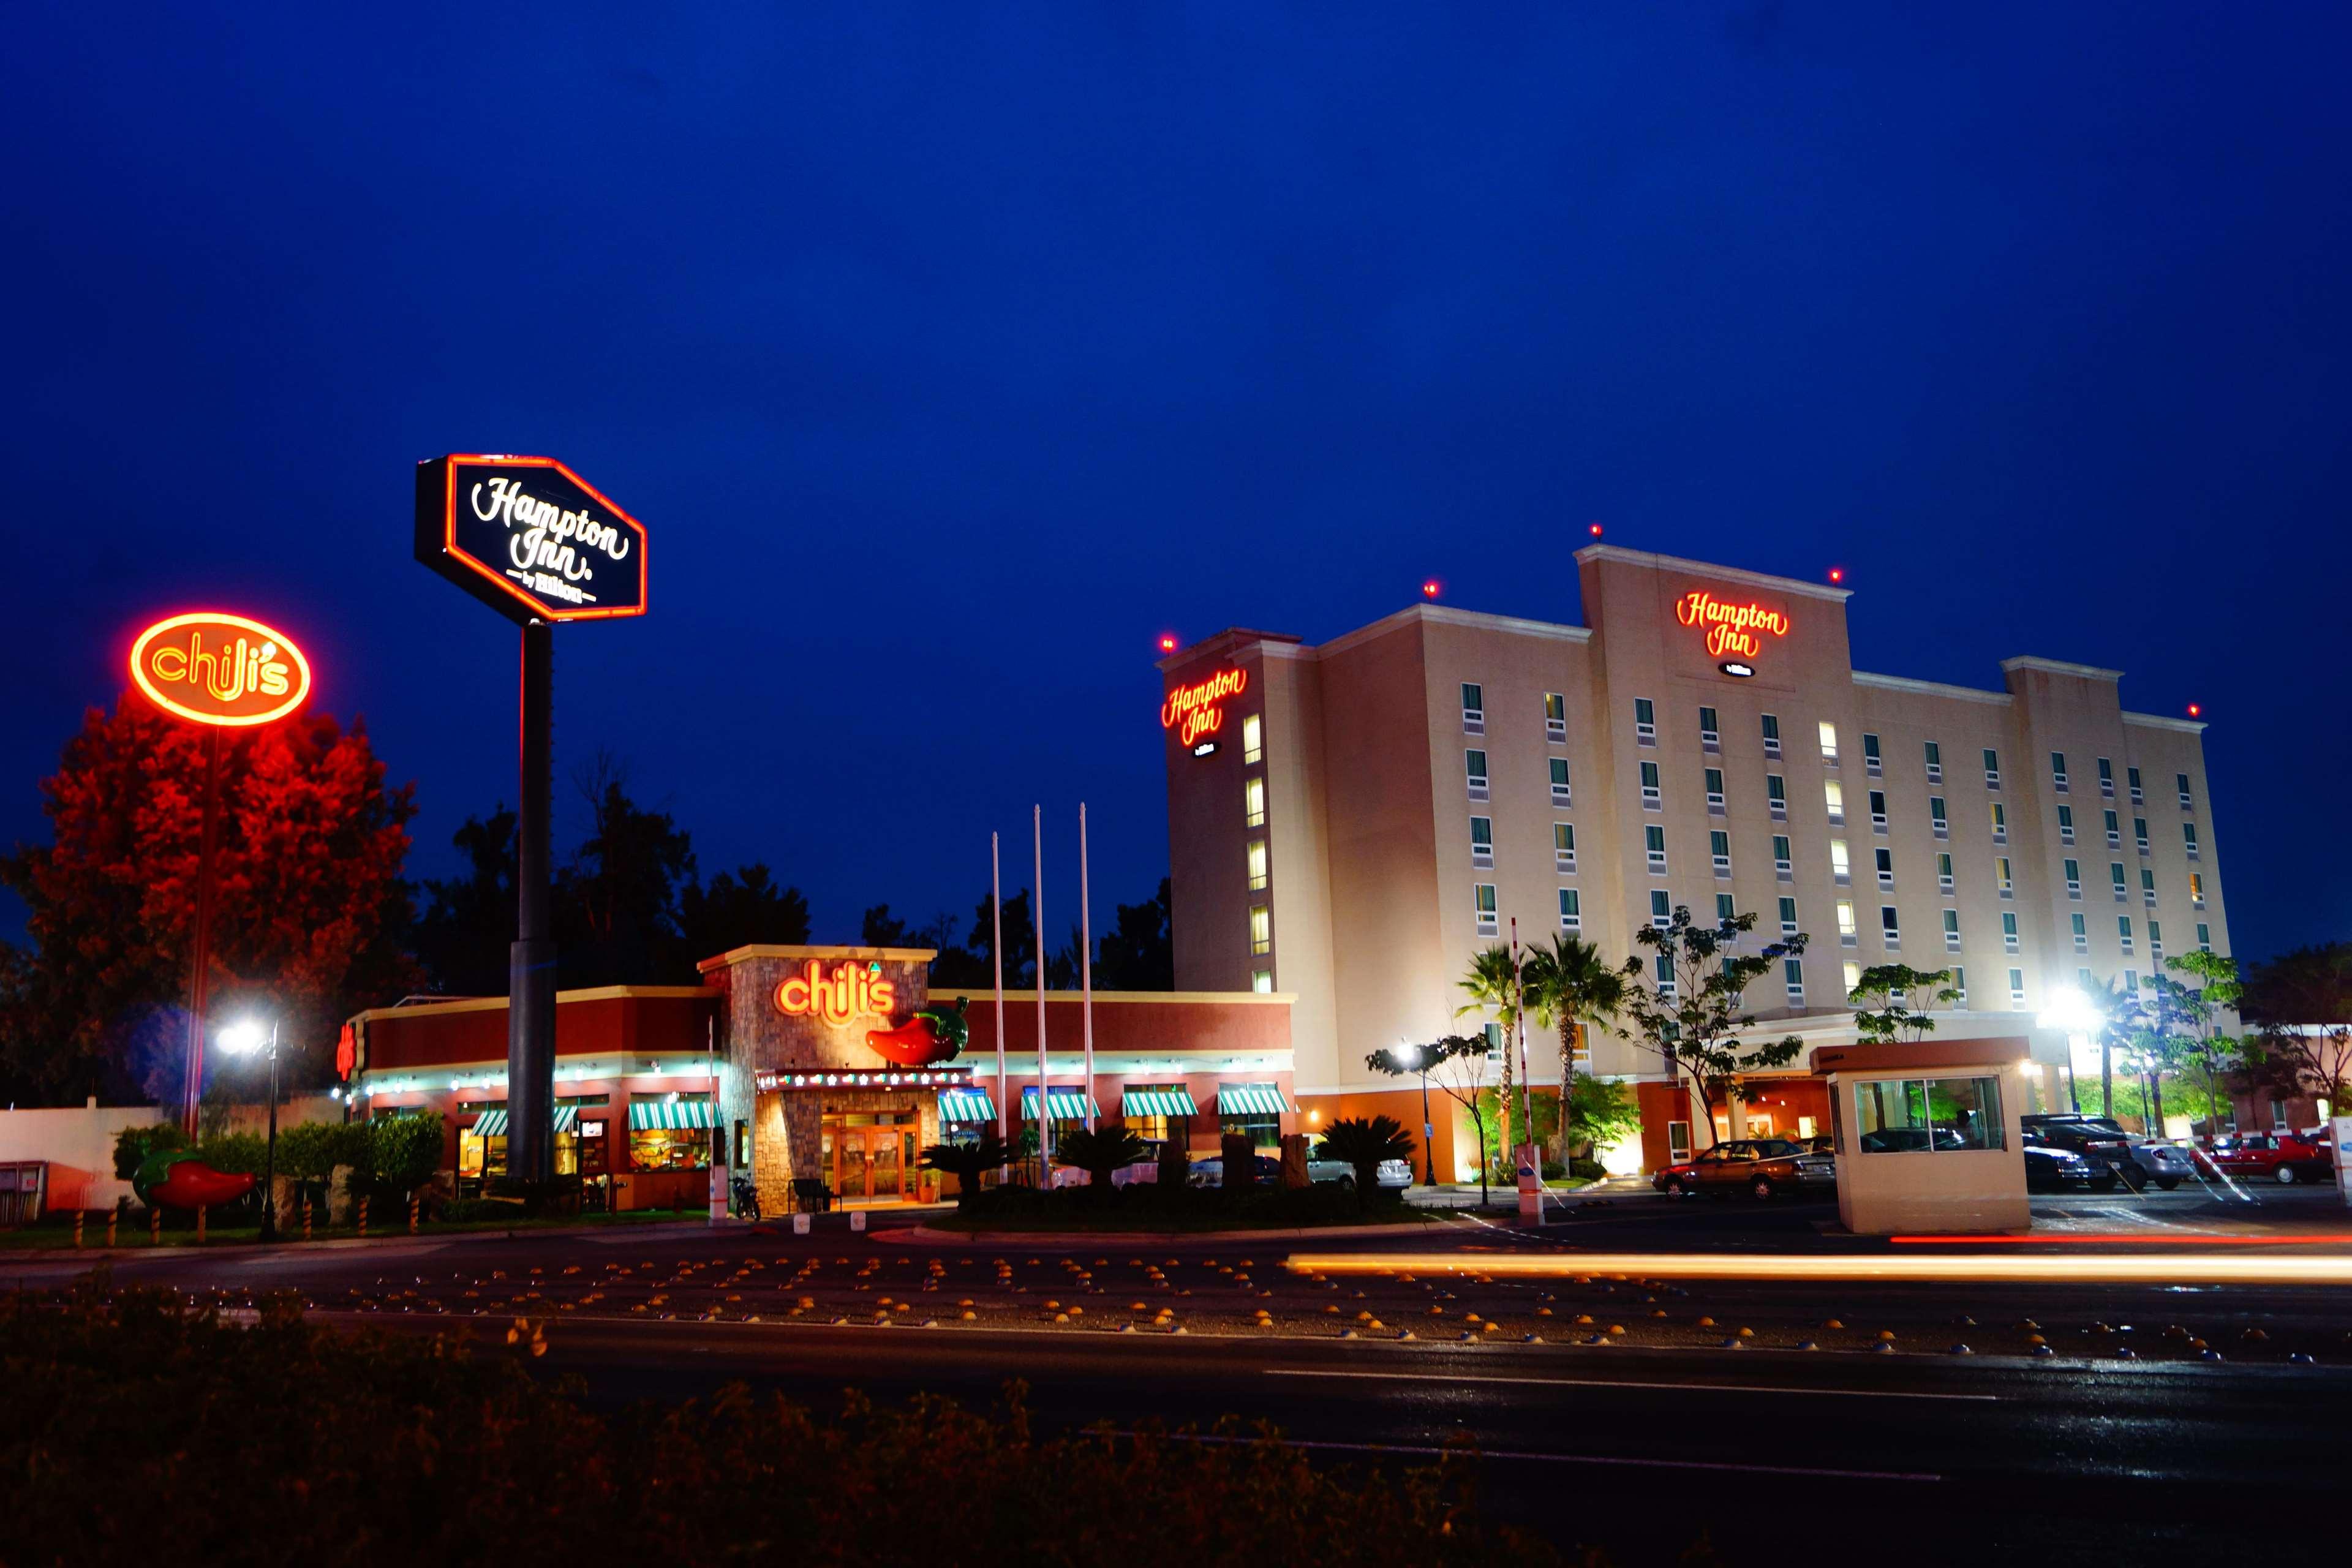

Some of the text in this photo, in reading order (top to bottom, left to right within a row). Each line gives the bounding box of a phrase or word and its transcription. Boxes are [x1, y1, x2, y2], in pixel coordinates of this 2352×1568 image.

[471, 477, 628, 560] Hampton
[510, 527, 587, 581] Inn
[1677, 592, 1788, 635] Hampton
[1706, 624, 1758, 657] Inn
[152, 632, 288, 701] chili's
[1161, 669, 1246, 728] Hampton
[1182, 707, 1222, 745] Inn
[776, 959, 894, 1024] chili's
